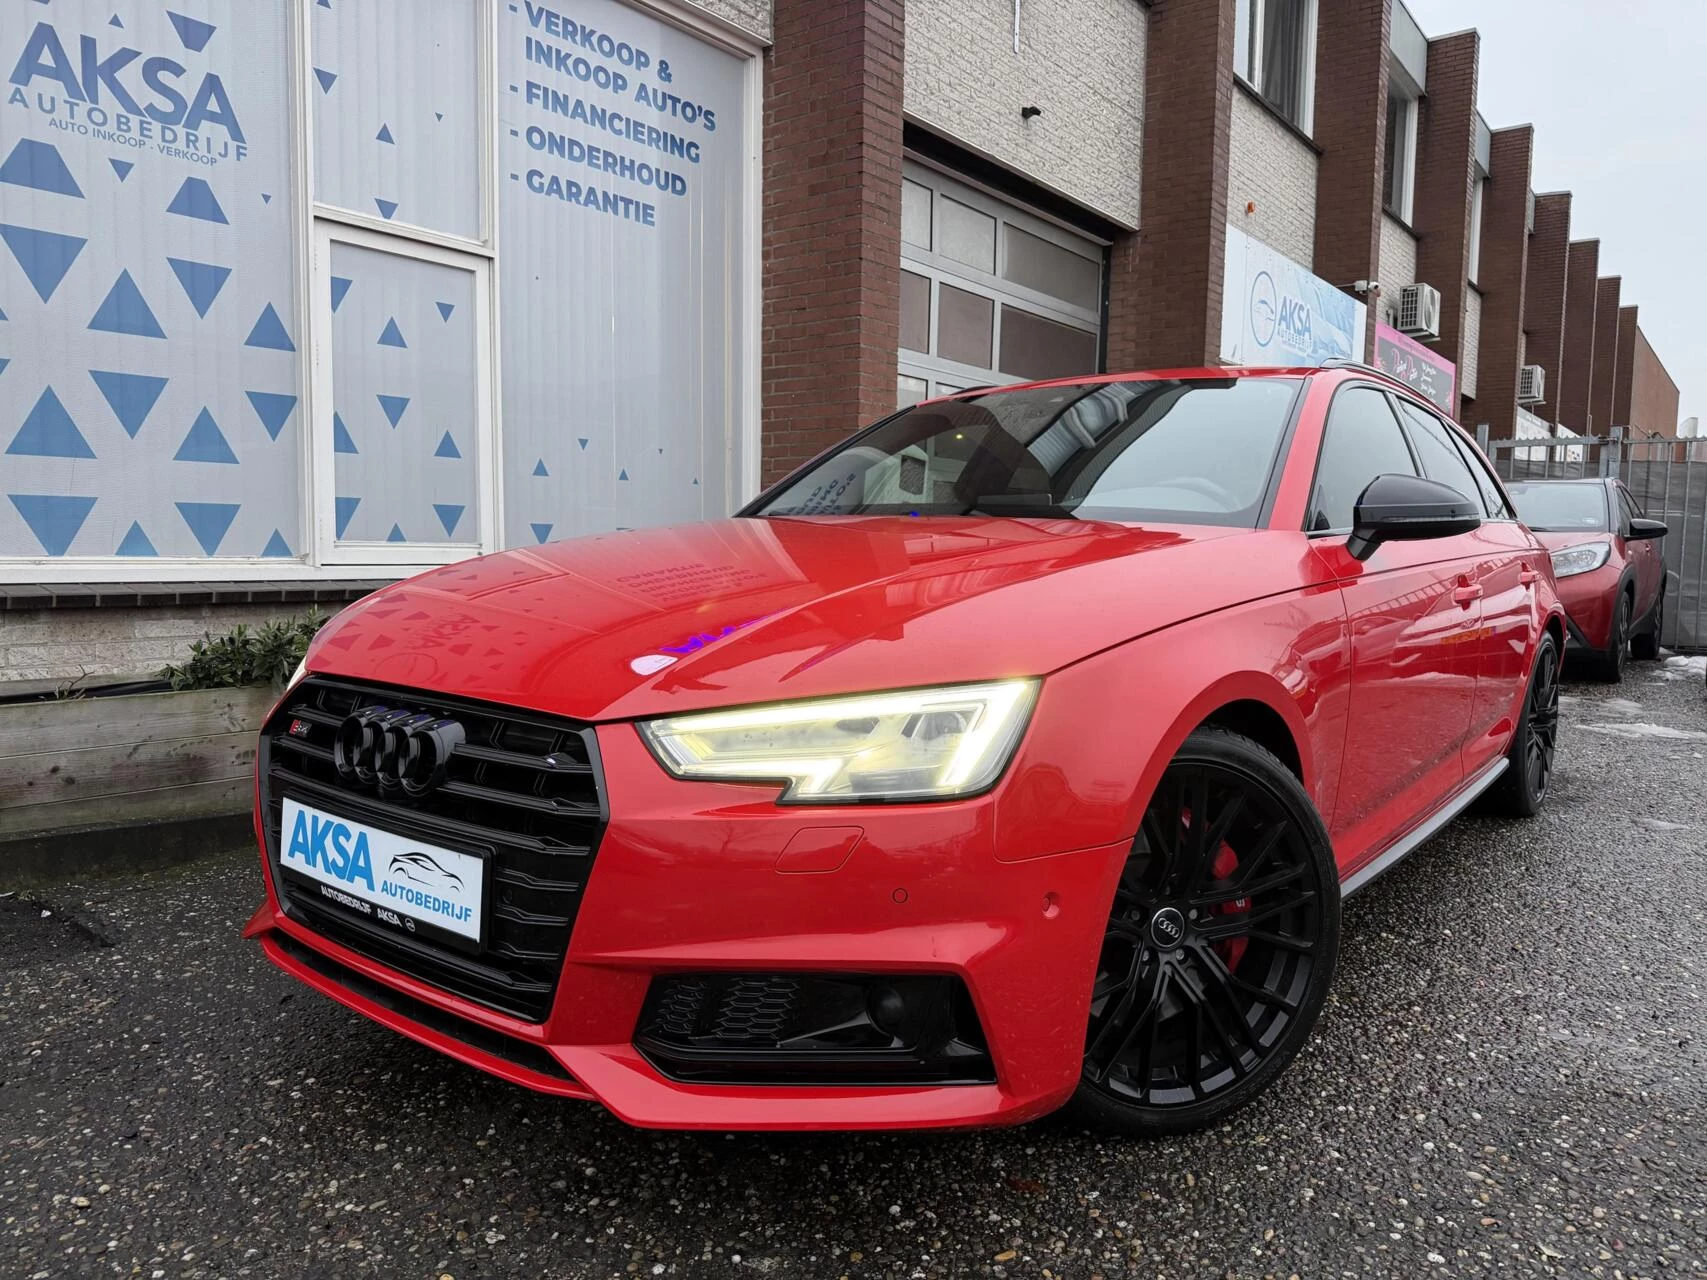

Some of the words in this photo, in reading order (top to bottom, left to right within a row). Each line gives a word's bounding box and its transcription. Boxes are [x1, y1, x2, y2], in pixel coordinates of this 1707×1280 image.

[524, 0, 650, 71] VERKOOP
[657, 59, 673, 83] &
[525, 36, 628, 94] INKOOP
[8, 21, 248, 145] AKSA
[8, 87, 248, 161] AUTOBEDRIJF
[48, 118, 89, 136] AUTO
[92, 127, 147, 149] INKOOP
[157, 144, 218, 167] VERKOOP
[525, 80, 700, 163] FINANCIERING
[525, 125, 687, 196] ONDERHOUD
[526, 168, 655, 227] GARANTIE
[1278, 295, 1312, 340] AKSA
[287, 809, 375, 892] AKSA
[376, 907, 403, 928] AKSA
[381, 879, 472, 922] AUTOBEDRIJF
